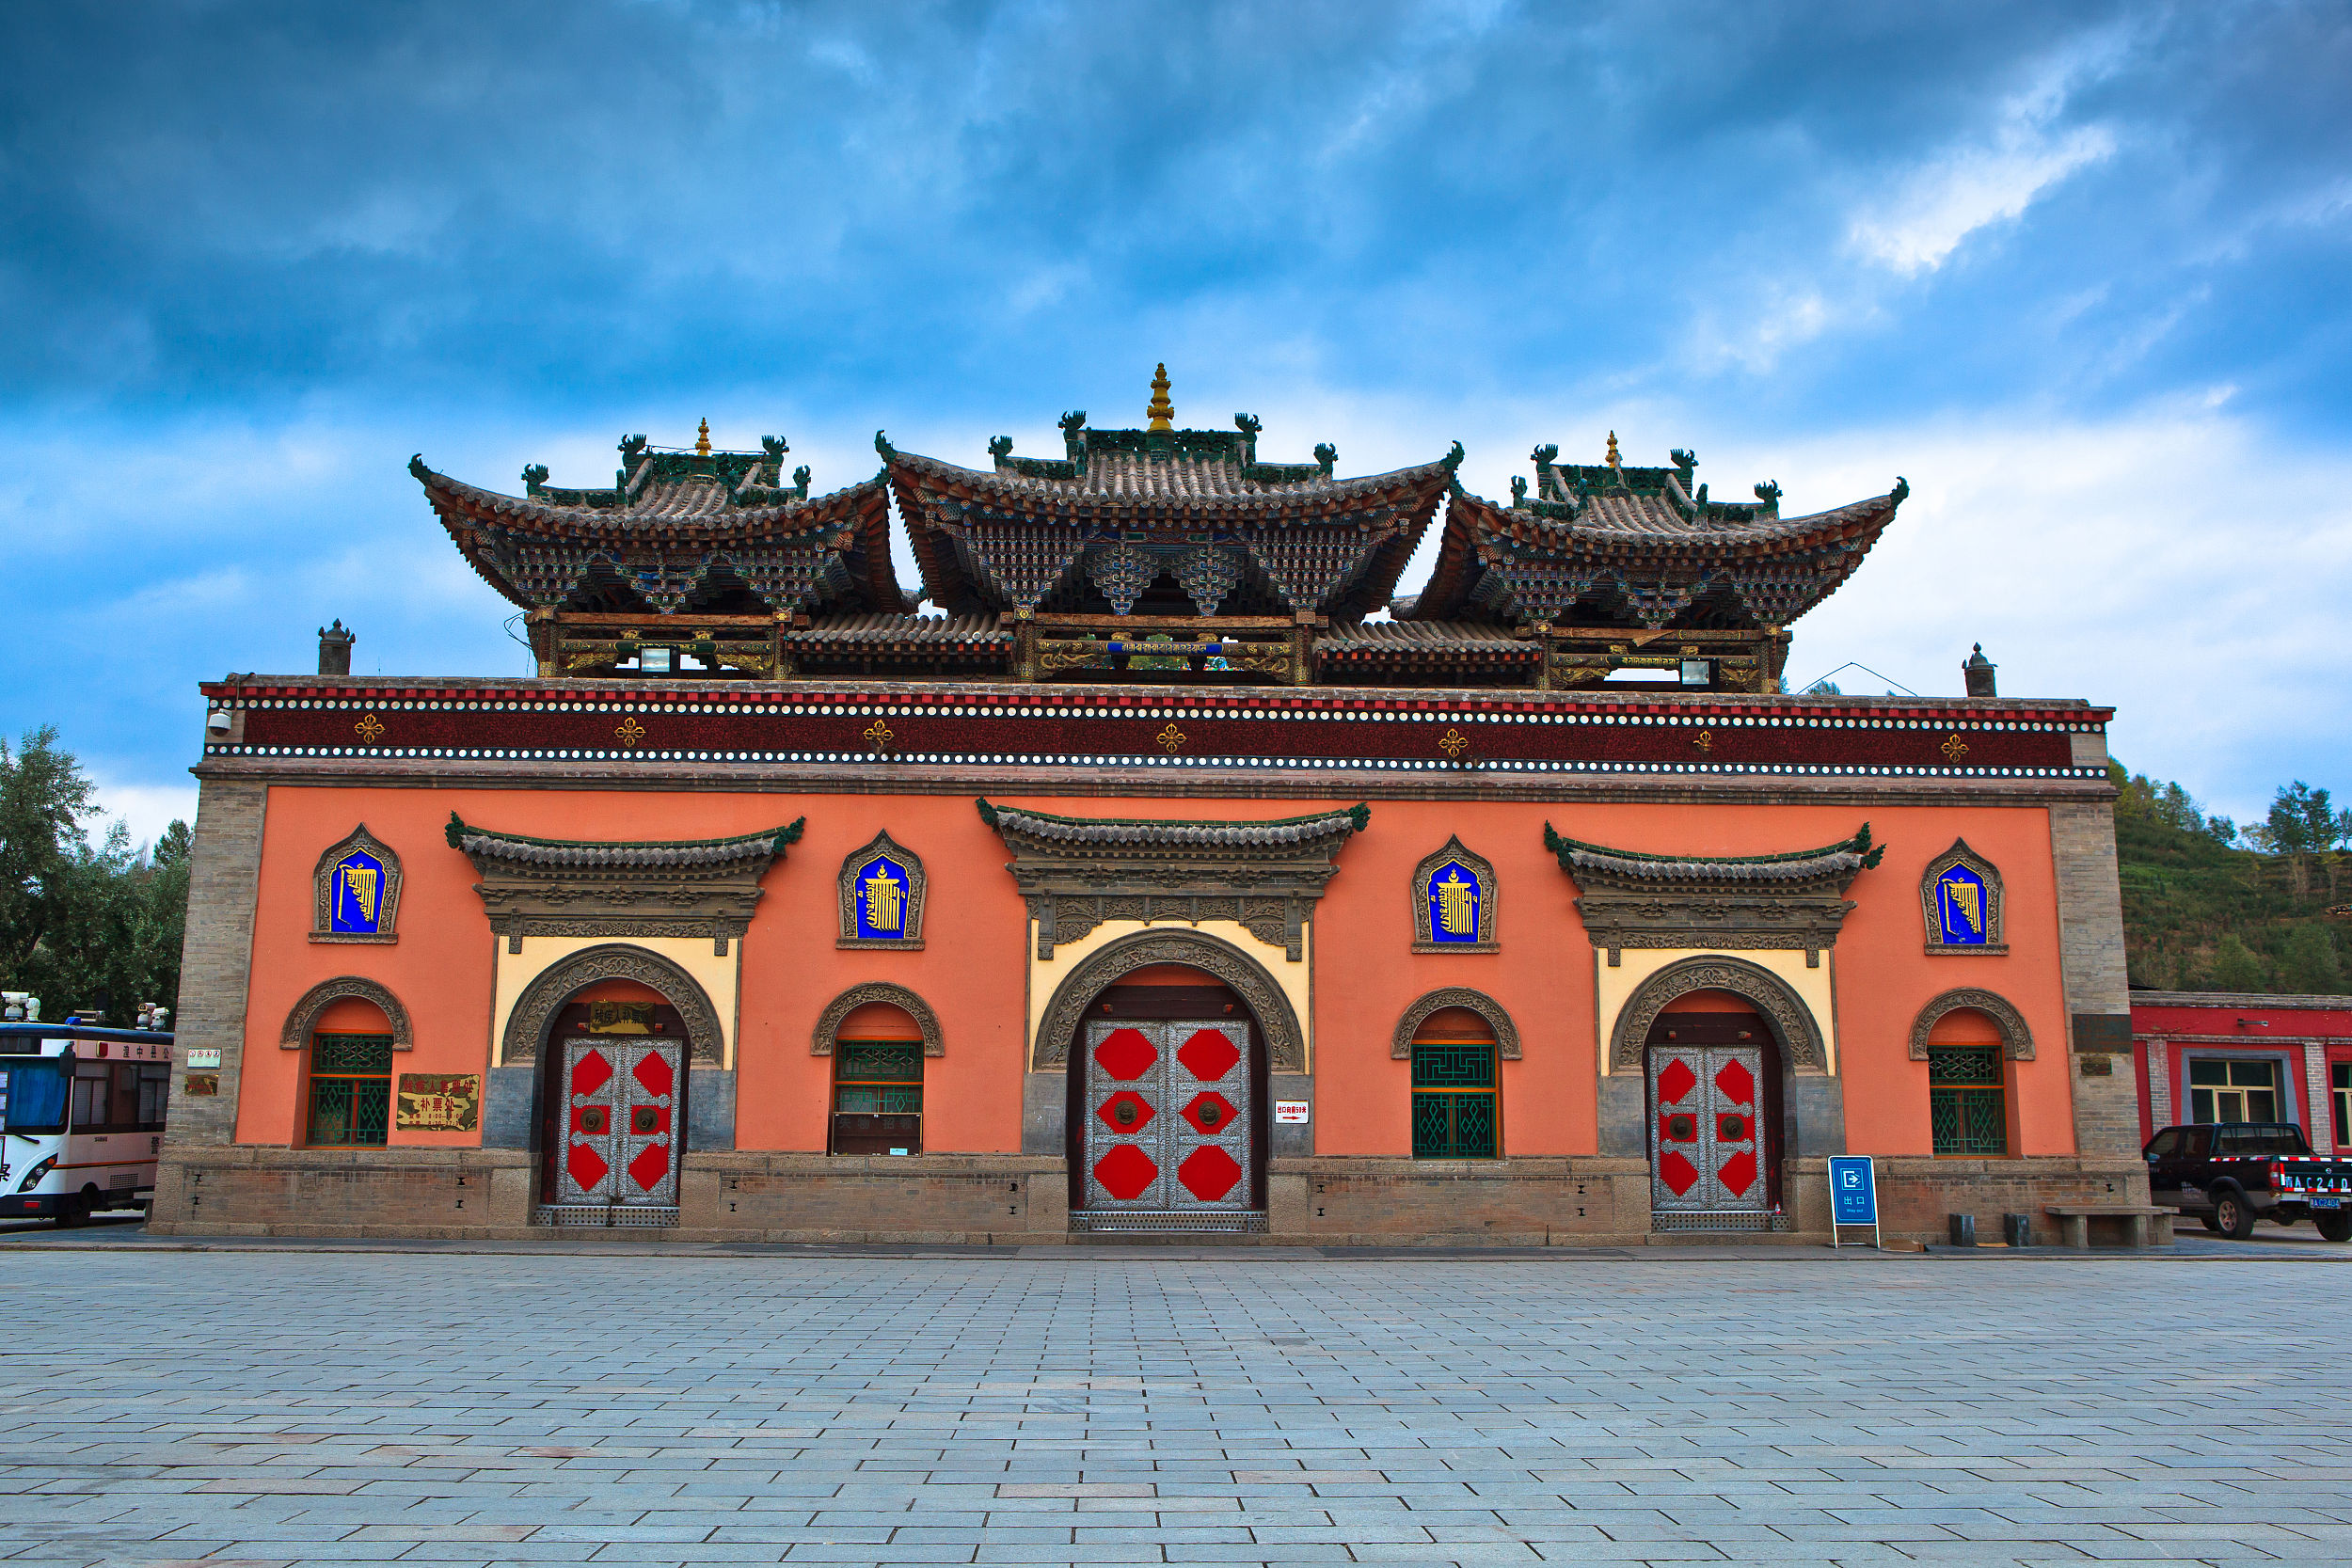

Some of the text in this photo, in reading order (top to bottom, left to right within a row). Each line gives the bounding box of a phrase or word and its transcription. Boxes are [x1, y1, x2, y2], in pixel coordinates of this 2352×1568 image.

[421, 1098, 454, 1112] 补票处
[1844, 1196, 1865, 1205] 出口
